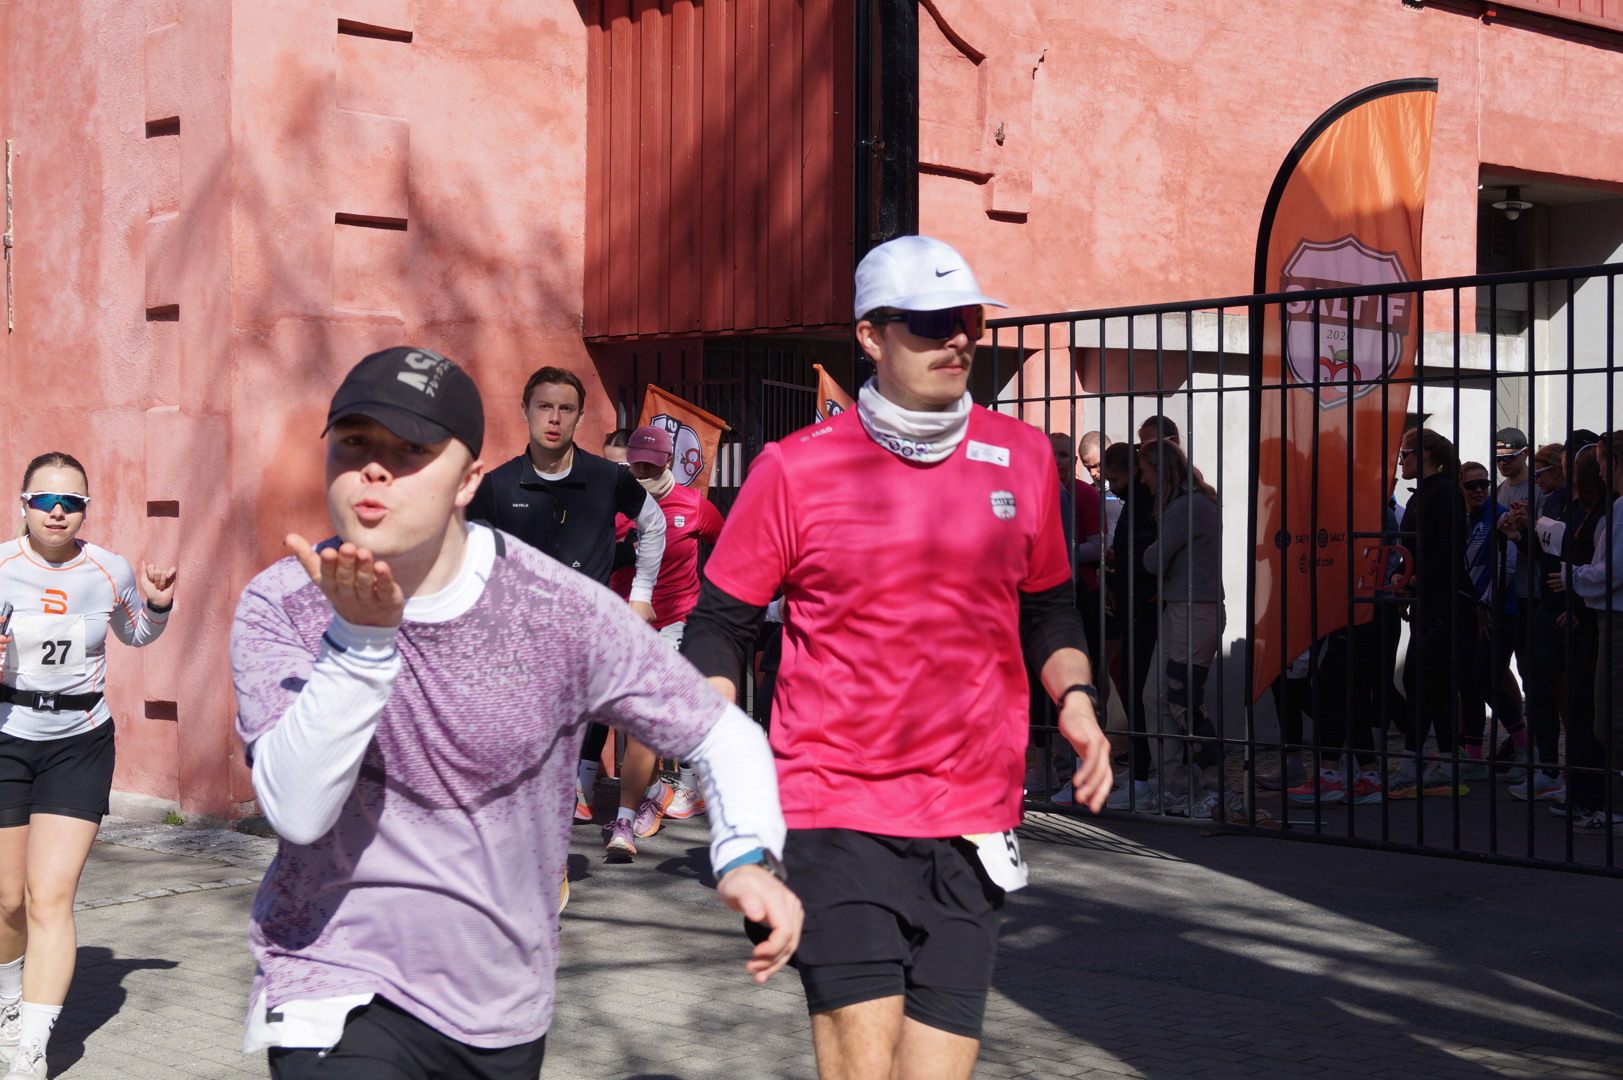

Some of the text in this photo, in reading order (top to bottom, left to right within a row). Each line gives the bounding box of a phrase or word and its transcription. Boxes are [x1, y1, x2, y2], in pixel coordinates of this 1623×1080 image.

[1326, 329, 1348, 341] 202
[1542, 531, 1552, 547] 44
[41, 640, 72, 665] 27
